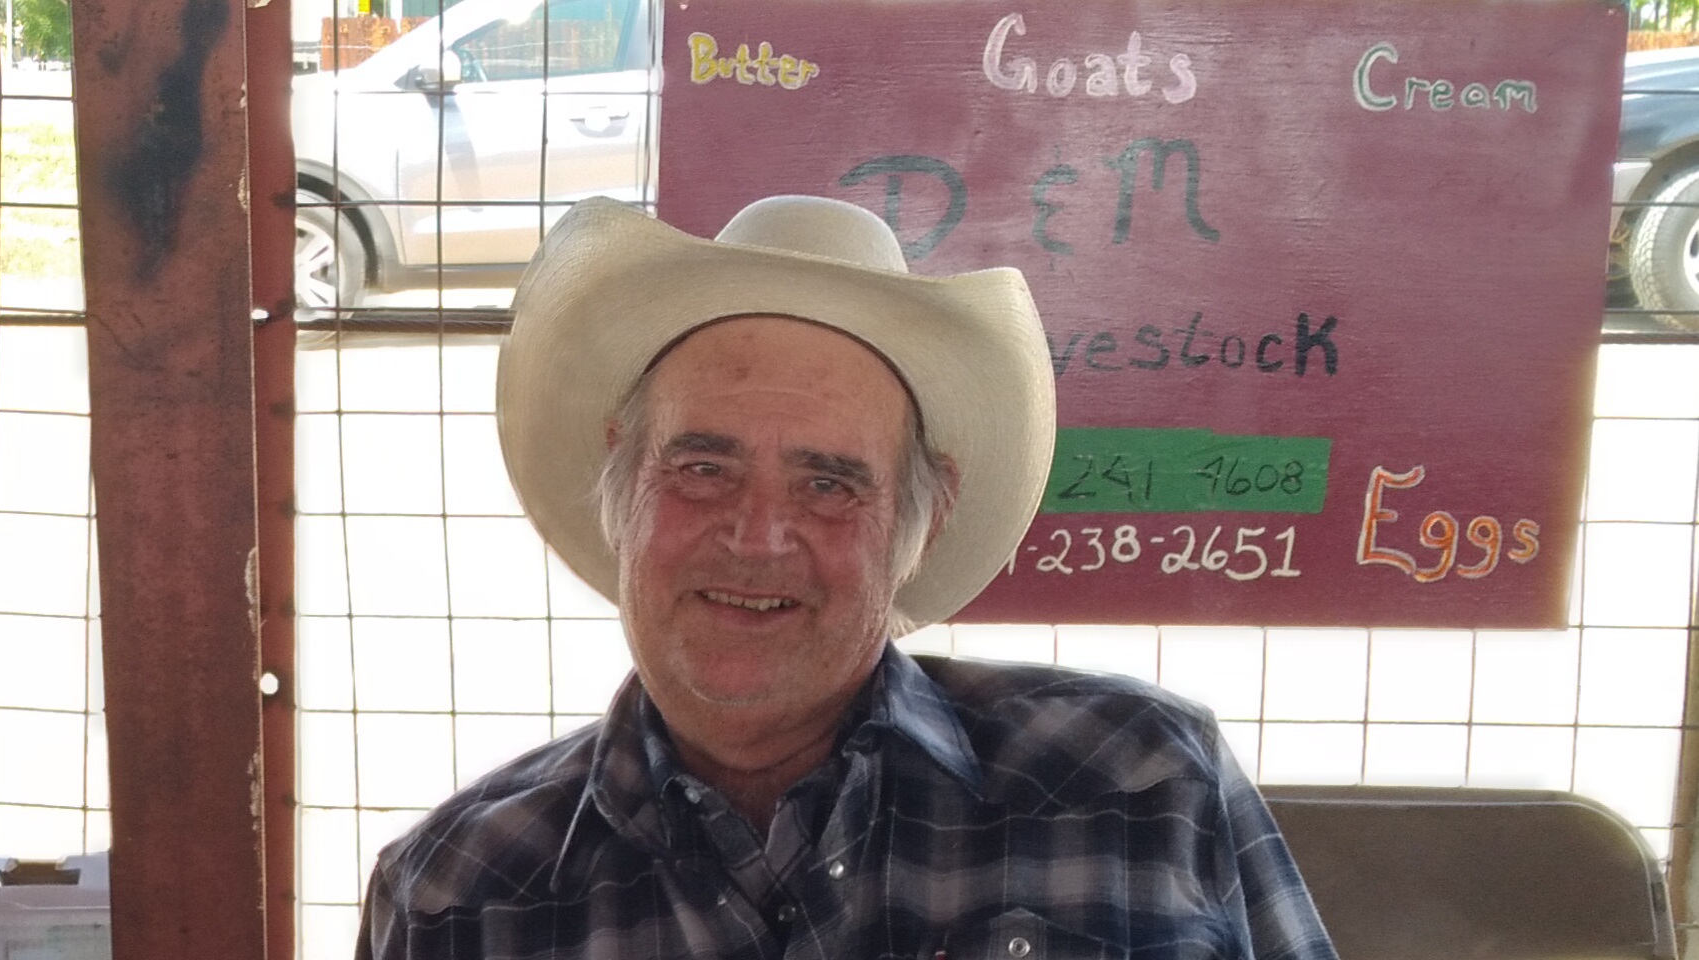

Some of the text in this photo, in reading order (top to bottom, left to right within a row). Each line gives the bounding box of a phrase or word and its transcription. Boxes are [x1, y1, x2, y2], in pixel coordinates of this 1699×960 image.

[688, 32, 820, 90] Butter
[983, 13, 1197, 104] Goats
[1354, 41, 1538, 114] Cream
[839, 154, 967, 260] D
[1103, 137, 1220, 245] M
[1195, 454, 1304, 497] 4608
[1356, 465, 1540, 583] Eggs
